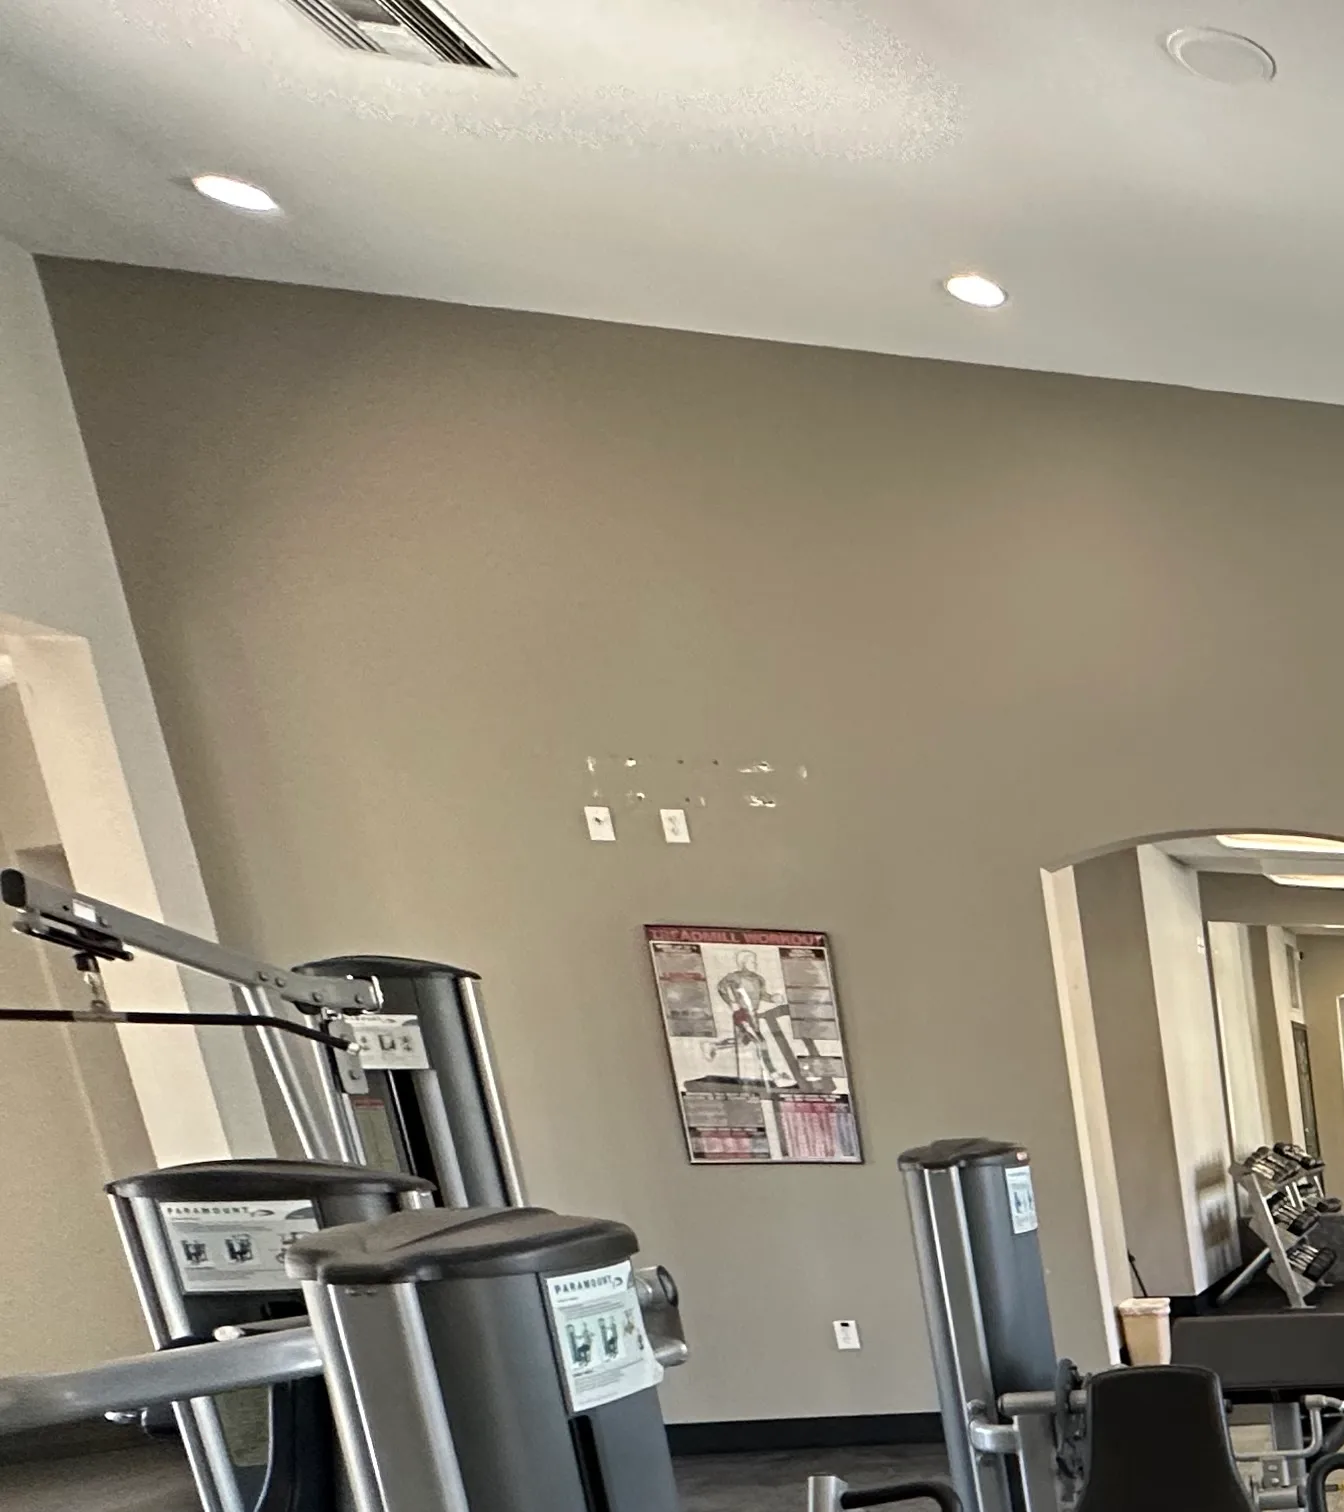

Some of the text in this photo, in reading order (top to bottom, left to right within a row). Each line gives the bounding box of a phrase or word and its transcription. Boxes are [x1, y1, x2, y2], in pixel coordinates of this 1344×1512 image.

[650, 929, 822, 945] TREADMILL WORKOUT
[554, 1275, 611, 1294] PARAMOUNT
